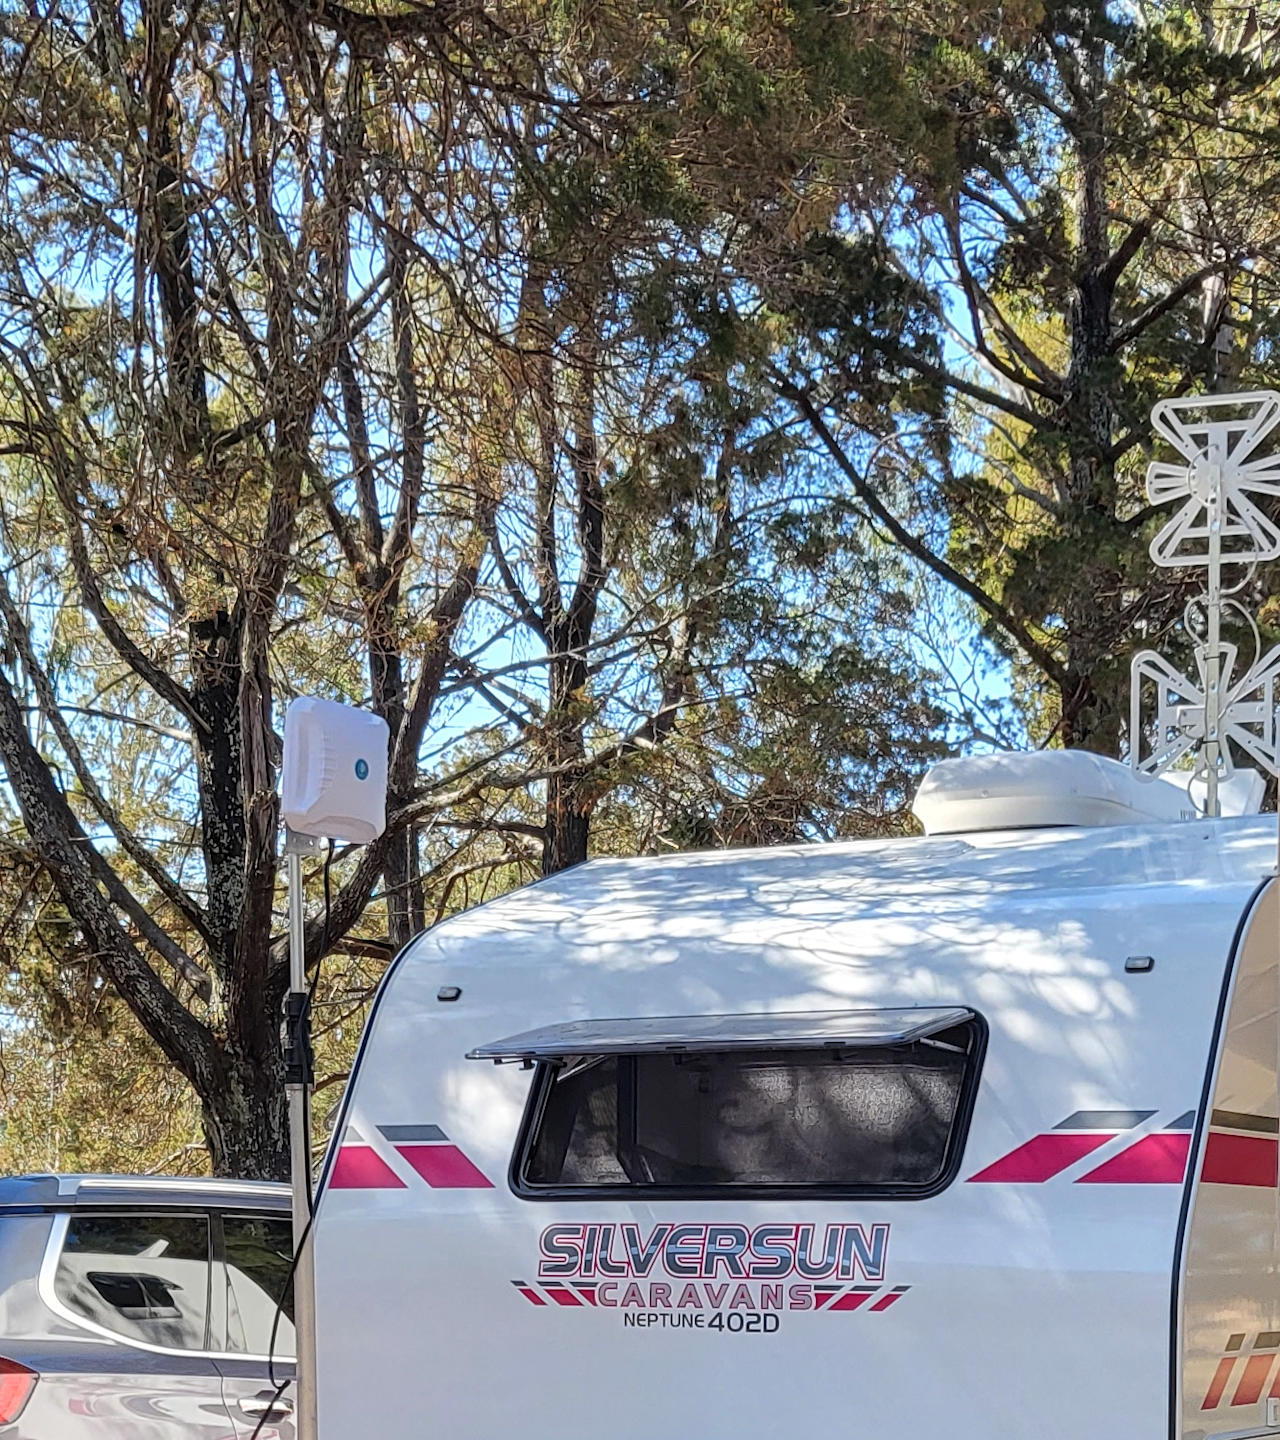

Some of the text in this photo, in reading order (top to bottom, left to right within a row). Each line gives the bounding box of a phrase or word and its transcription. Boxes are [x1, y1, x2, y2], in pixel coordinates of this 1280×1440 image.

[538, 1223, 891, 1281] SILVERSUN
[598, 1282, 813, 1311] CARAVANS
[624, 1312, 780, 1333] NEPTUNE 402D
